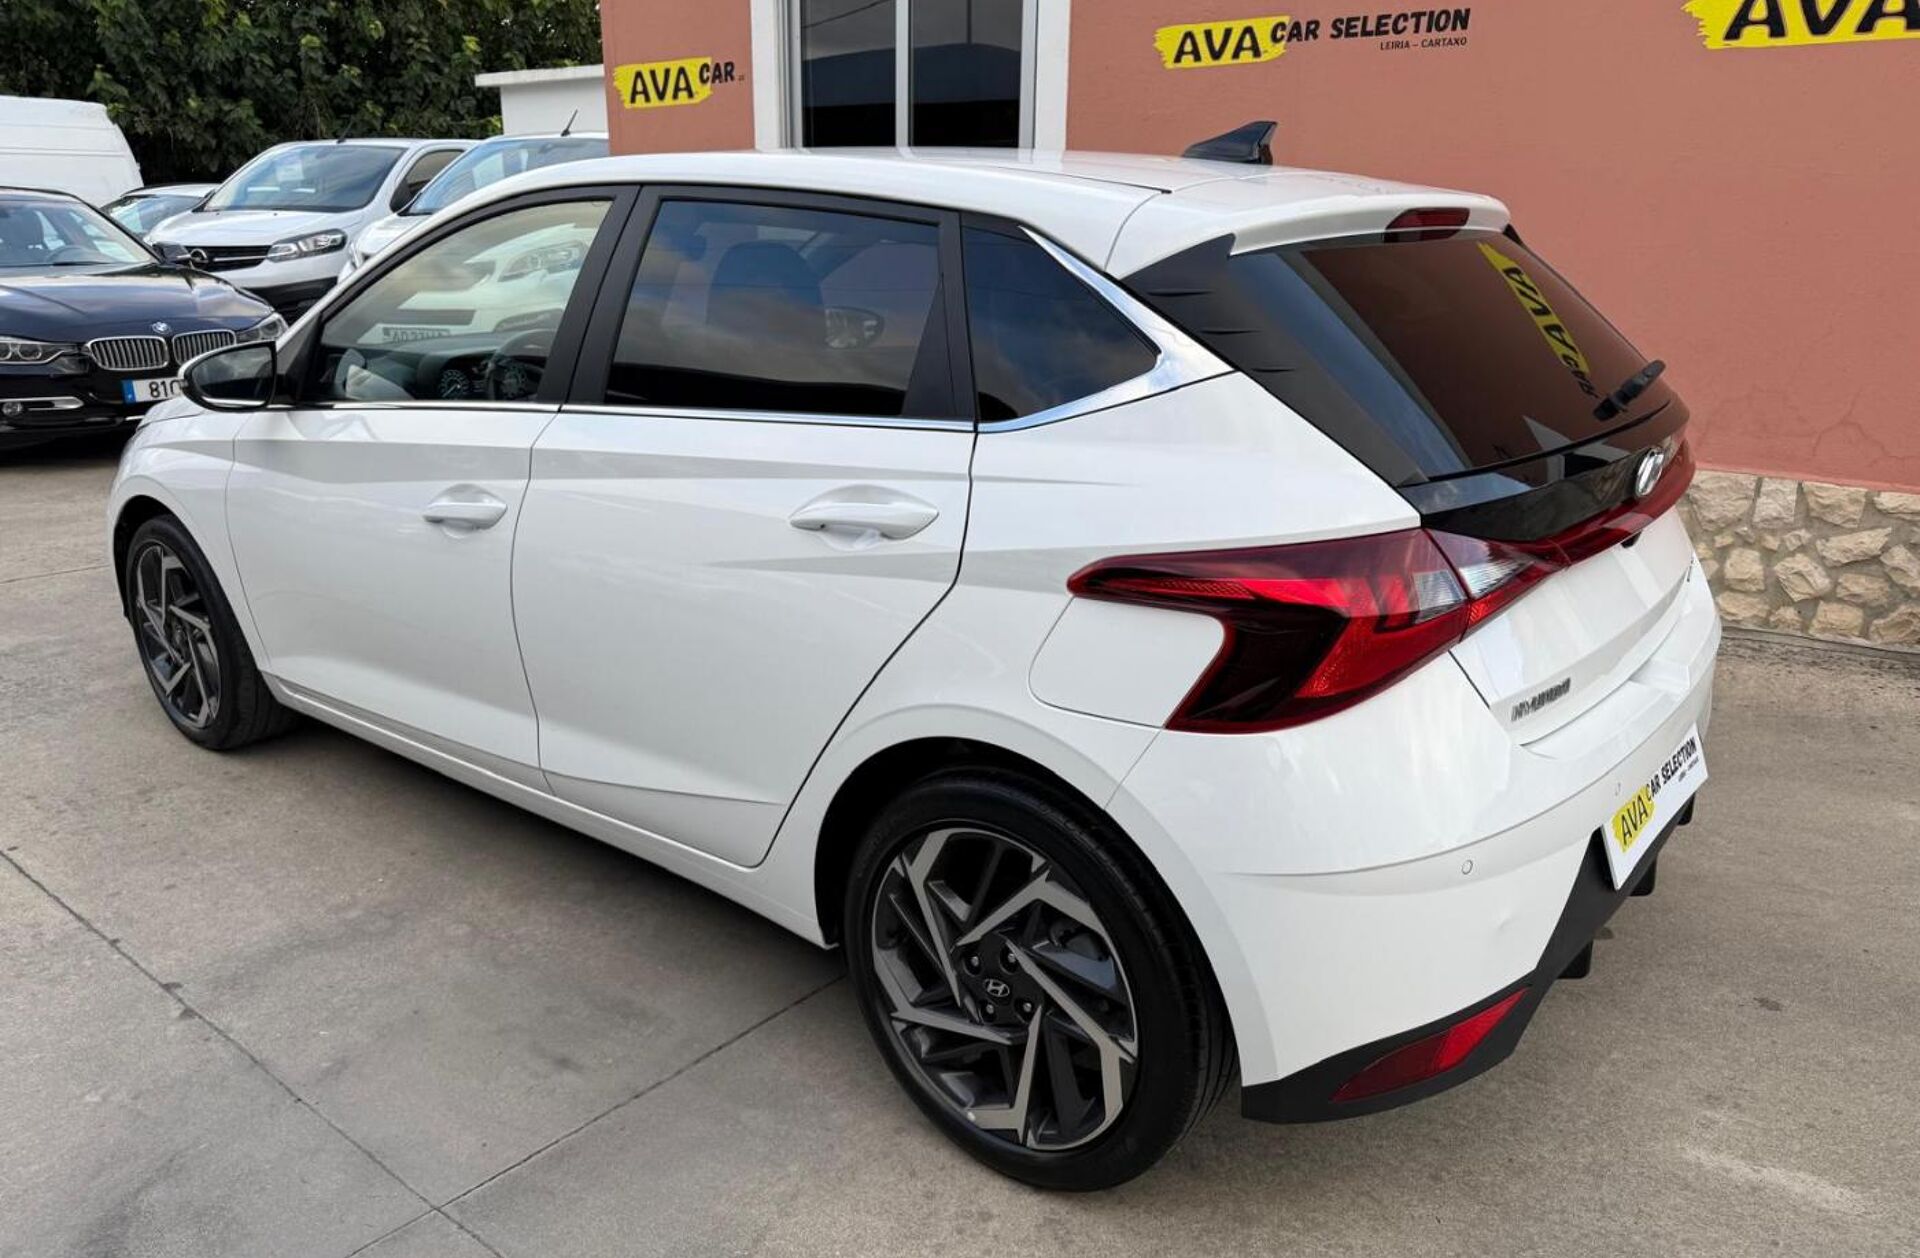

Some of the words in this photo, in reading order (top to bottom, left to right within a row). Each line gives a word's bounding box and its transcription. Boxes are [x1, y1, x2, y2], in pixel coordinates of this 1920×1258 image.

[1173, 25, 1263, 63] AVA
[1270, 20, 1320, 43] CAR
[1330, 8, 1471, 39] SELECTION
[1723, 0, 1920, 41] AVA
[1380, 40, 1410, 50] LEIRIA
[1421, 37, 1467, 48] CARTAXO
[630, 66, 695, 104] AVA
[699, 61, 735, 84] CAR
[1620, 794, 1649, 846] AVA
[1646, 774, 1661, 802] CAR
[1661, 736, 1698, 785] SELECTION
